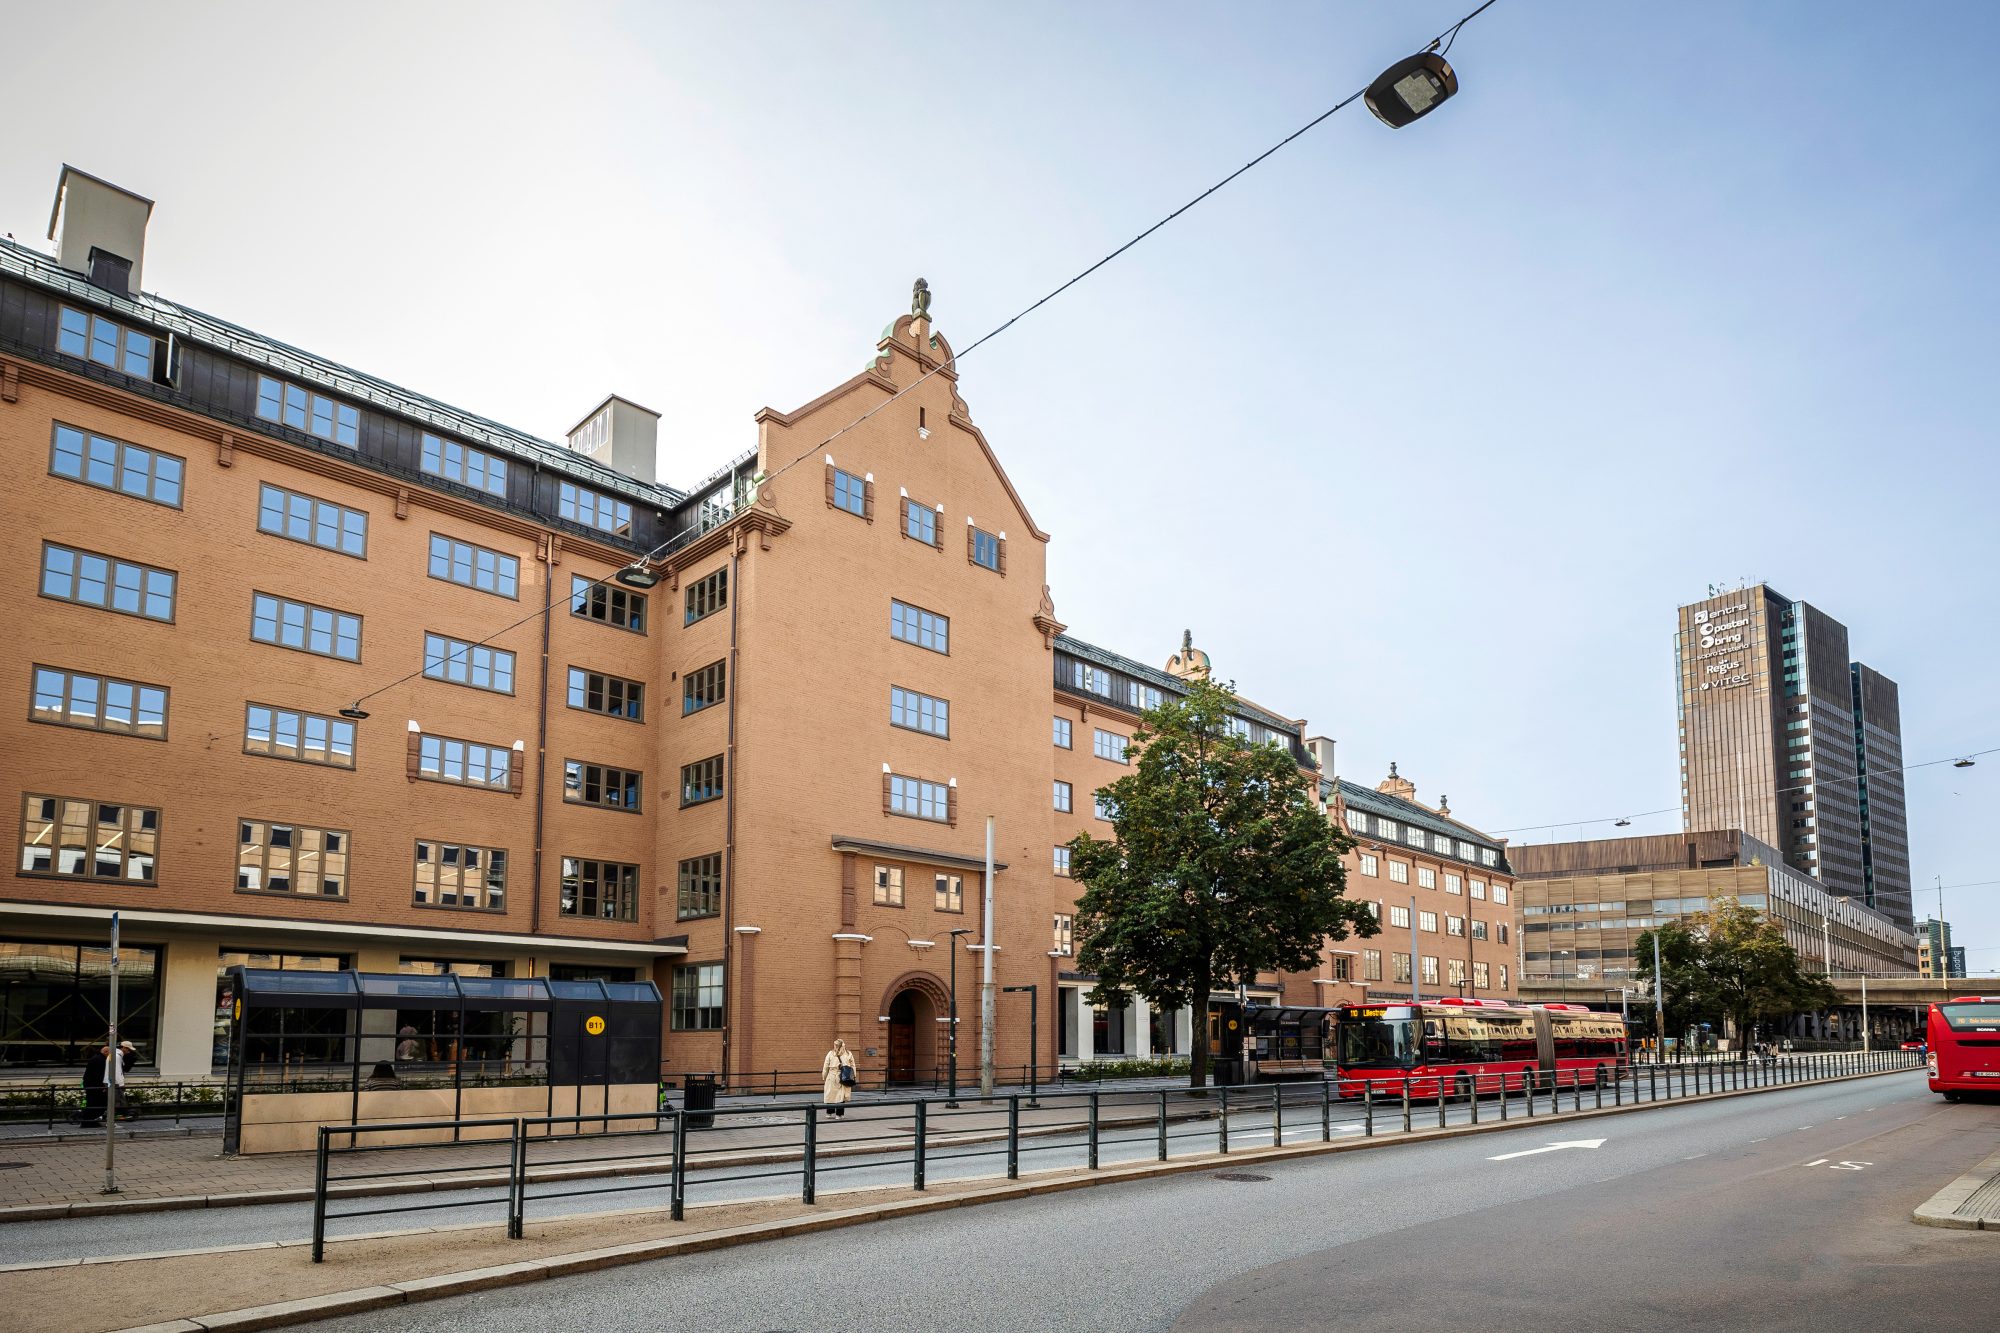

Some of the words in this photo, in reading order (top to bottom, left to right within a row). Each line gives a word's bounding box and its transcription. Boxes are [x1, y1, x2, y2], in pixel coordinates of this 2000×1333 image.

[1709, 603, 1747, 619] entra
[1714, 618, 1749, 634] posten
[1714, 633, 1742, 646] bring
[1706, 661, 1740, 675] Regus
[588, 1021, 603, 1029] B11
